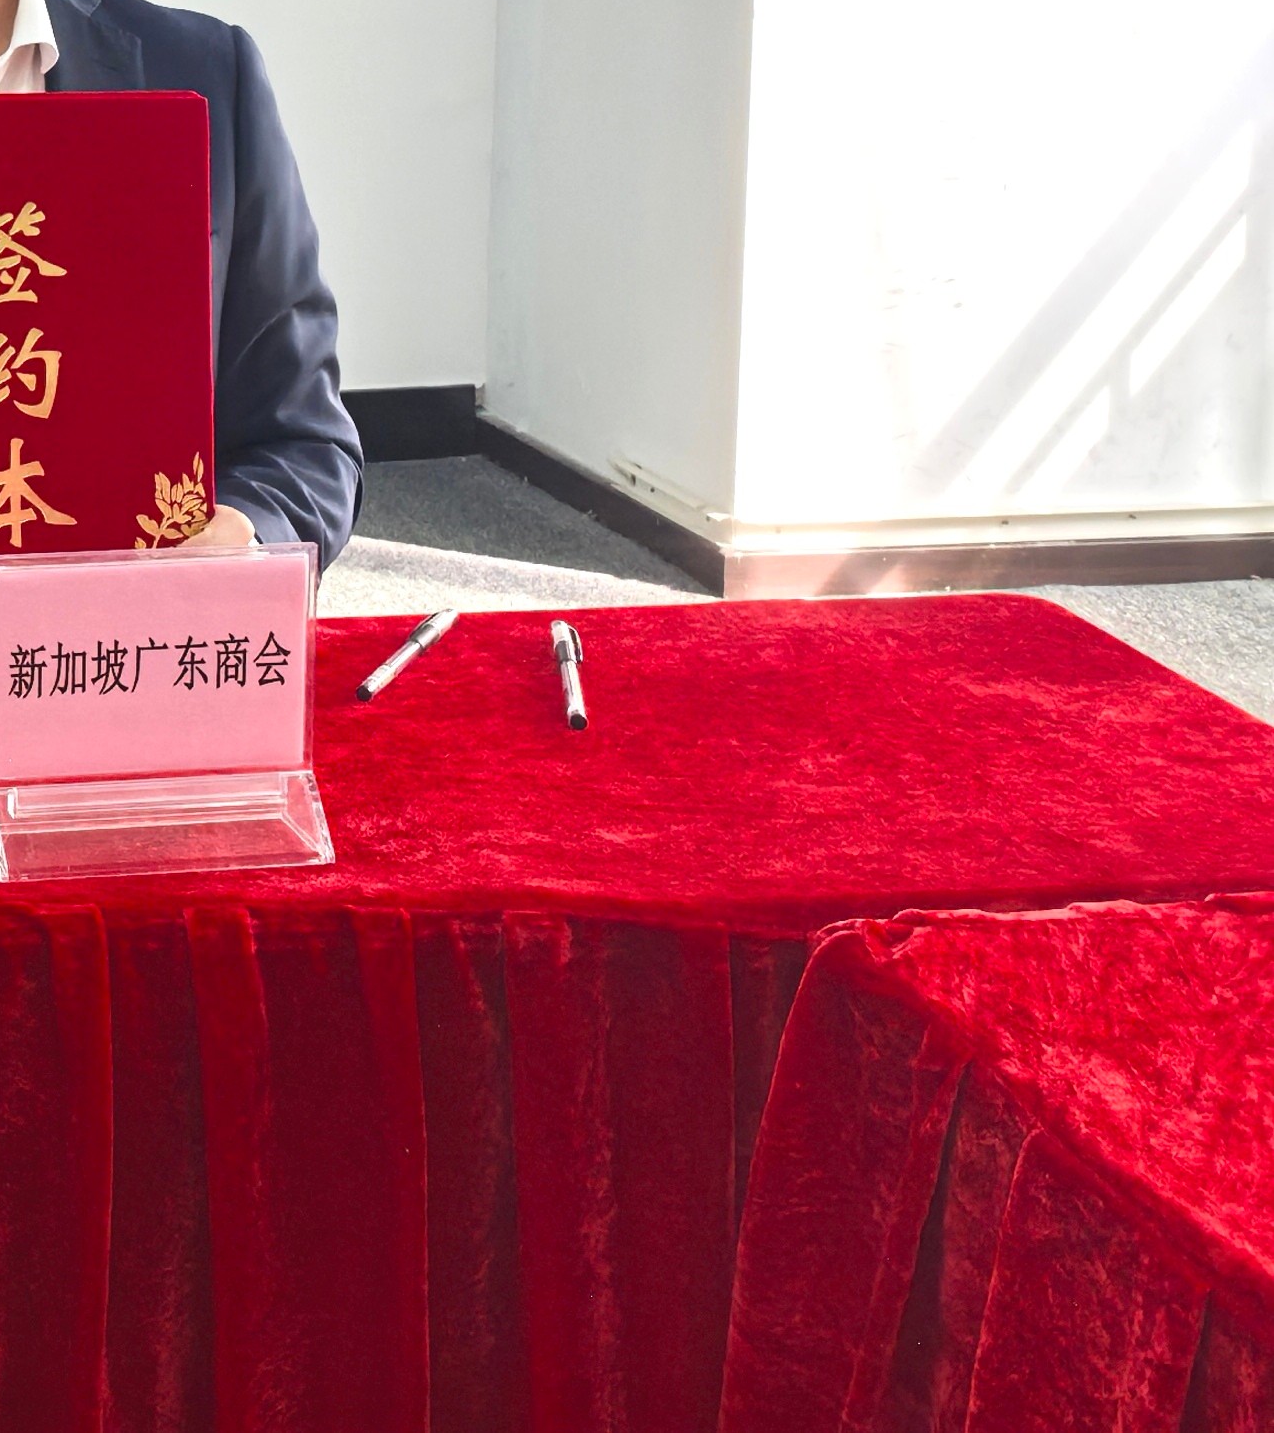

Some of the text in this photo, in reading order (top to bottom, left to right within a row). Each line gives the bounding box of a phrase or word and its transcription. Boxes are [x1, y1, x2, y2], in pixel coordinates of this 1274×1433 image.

[8, 631, 291, 699] 新加坡广东商会
